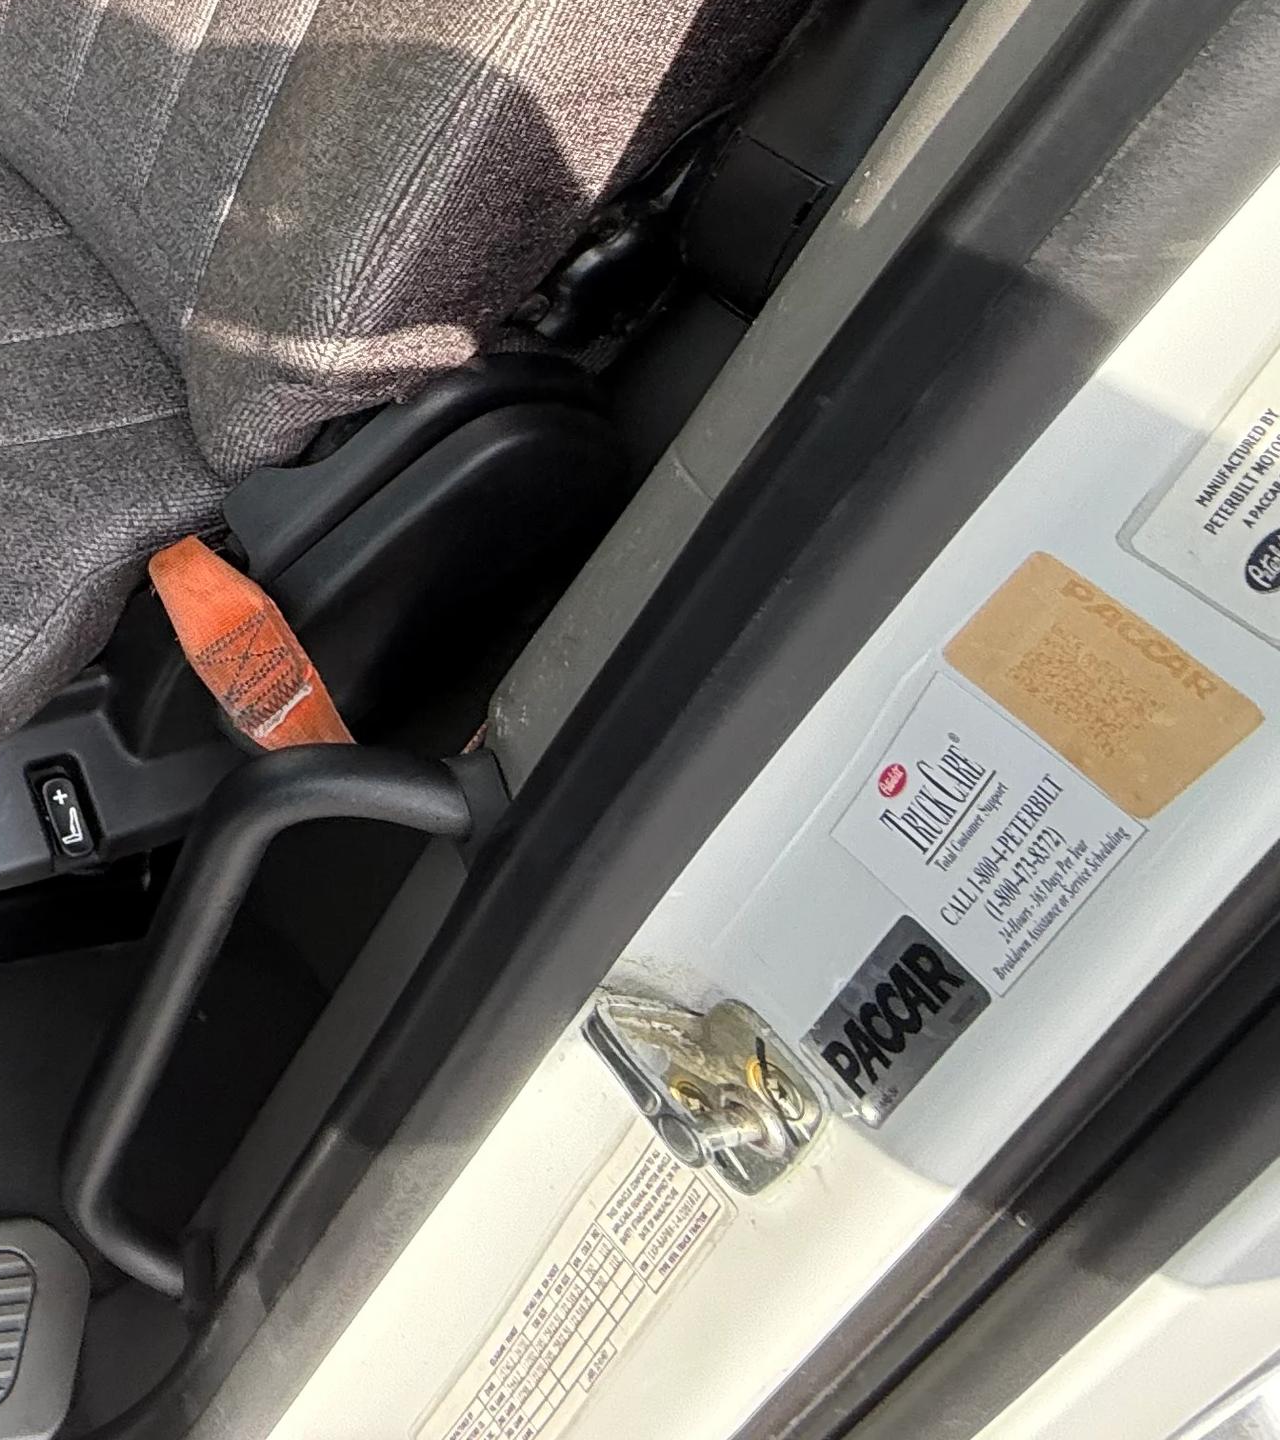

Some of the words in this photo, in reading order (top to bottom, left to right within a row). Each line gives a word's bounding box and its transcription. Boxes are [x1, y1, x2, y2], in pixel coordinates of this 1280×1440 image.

[1194, 423, 1267, 508] MANUFACTURED
[1259, 407, 1279, 427] BY
[1202, 471, 1259, 536] PETERBILT
[1241, 519, 1255, 529] A
[1059, 576, 1219, 700] PACCAR
[879, 784, 958, 855] TRUCK
[933, 846, 957, 872] Total
[949, 813, 984, 852] Customer
[976, 780, 1008, 815] Support
[937, 883, 978, 927] CALL
[964, 772, 1064, 892] 1-800-4-PETERBILT
[1082, 824, 1131, 872] Scheduling
[981, 824, 1067, 923] (1-800-473-8372)
[1038, 869, 1066, 893] Days
[1053, 855, 1074, 874] Per
[1066, 838, 1089, 859] Year
[1060, 866, 1092, 899] Service
[1024, 901, 1063, 943] Assistance
[1055, 892, 1070, 907] or
[991, 938, 1033, 981] Breakdown
[819, 941, 965, 1099] PACCAR
